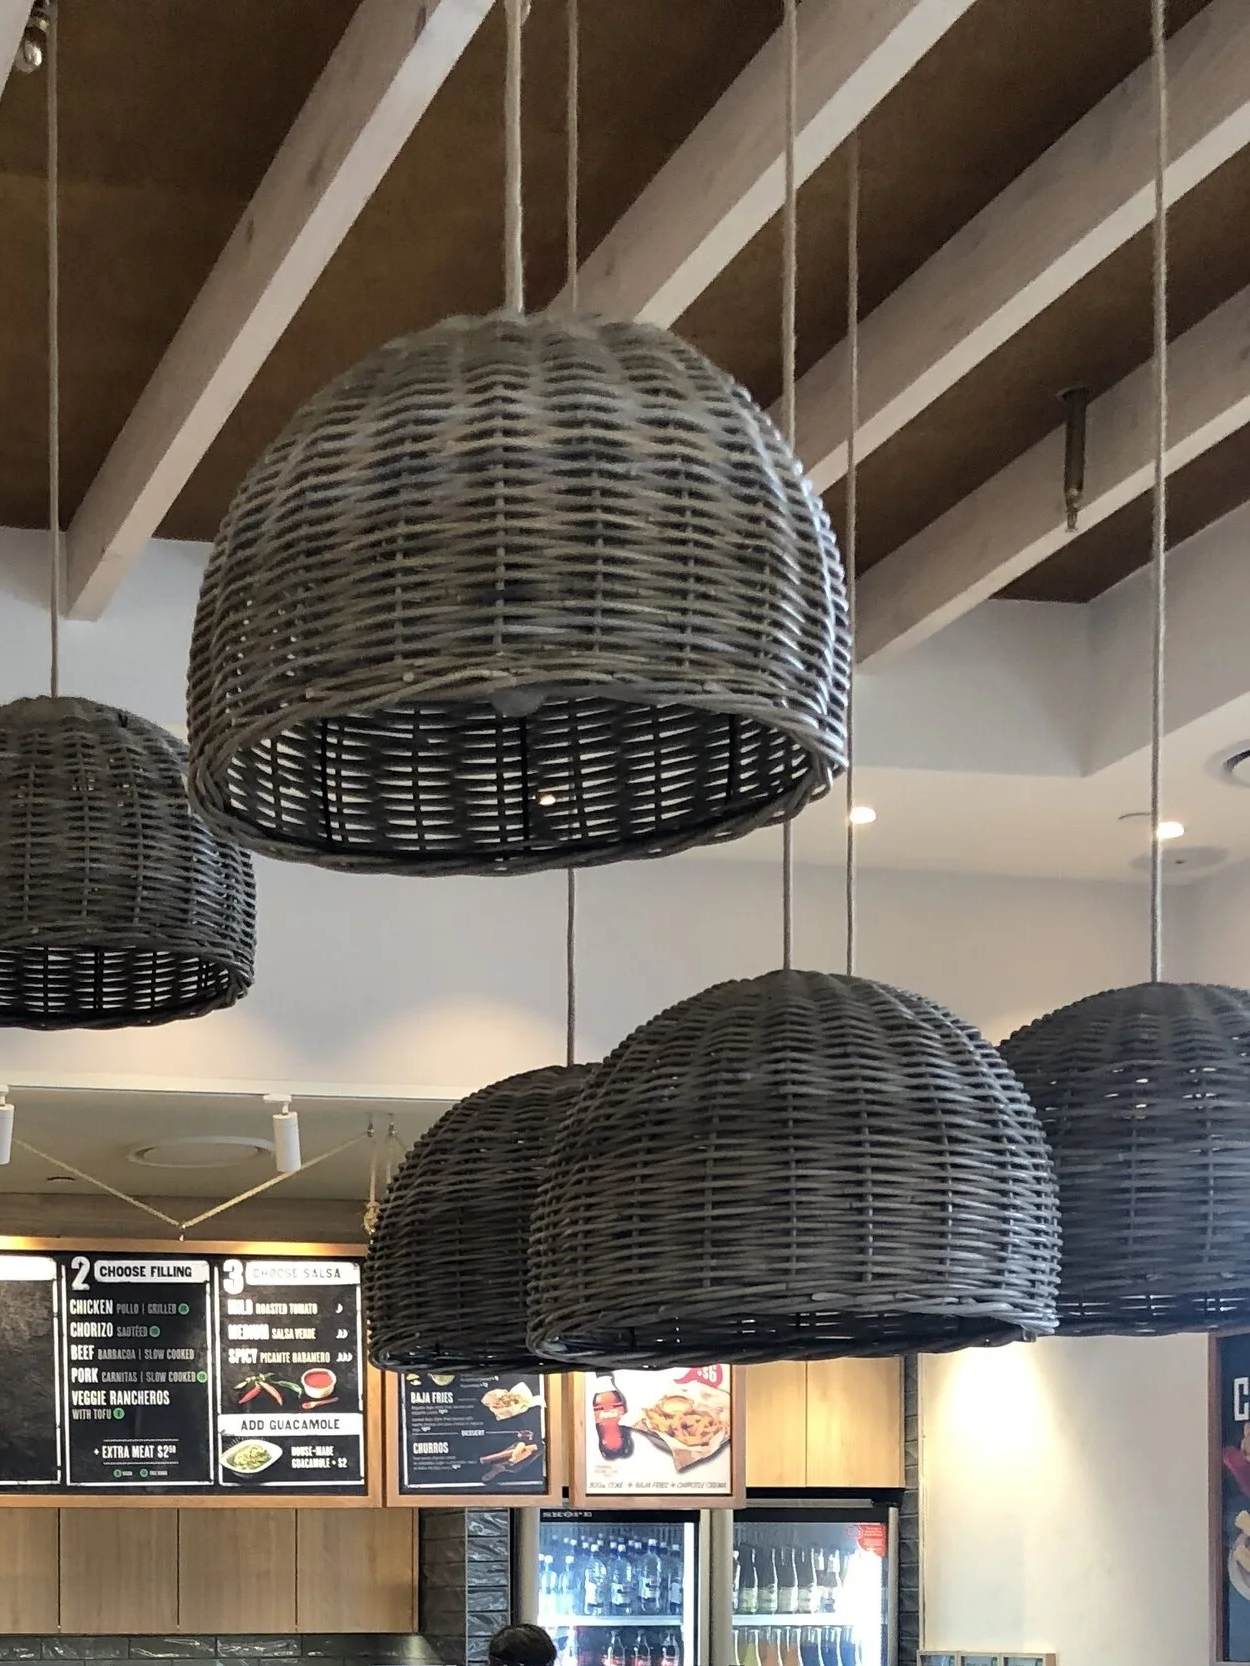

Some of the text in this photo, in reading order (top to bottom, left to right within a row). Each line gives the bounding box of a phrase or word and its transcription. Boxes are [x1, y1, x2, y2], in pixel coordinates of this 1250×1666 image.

[71, 1256, 90, 1290] 2
[100, 1266, 192, 1277] CHOOSE FILLING
[223, 1259, 244, 1295] 3
[253, 1268, 341, 1278] CHOOSE SALSA
[70, 1299, 113, 1315] CHICKEN
[116, 1304, 138, 1314] POLLO
[255, 1303, 287, 1314] ROASTED
[70, 1322, 113, 1338] CHORIZO
[271, 1328, 294, 1339] SALSA
[294, 1328, 316, 1339] VERDE
[70, 1345, 94, 1360] BEEF
[144, 1349, 164, 1360] SLOW
[166, 1349, 195, 1360] COOKED
[228, 1348, 258, 1364] SPICY
[260, 1352, 290, 1363] PICANTE
[71, 1367, 196, 1383] PORK CARNITAS SLOW COOKED
[72, 1390, 170, 1406] VEGGIE RANCHEROS
[411, 1392, 453, 1403] BAJA FRIES
[72, 1409, 111, 1420] WITH TOFU
[241, 1419, 340, 1430] ADD GUACAMOLE
[102, 1445, 129, 1458] EXTRA
[132, 1445, 154, 1458] MEAT
[291, 1446, 334, 1456] HOUSE-MADE
[413, 1442, 449, 1454] CHURROS
[291, 1458, 331, 1468] GUACAMOLE
